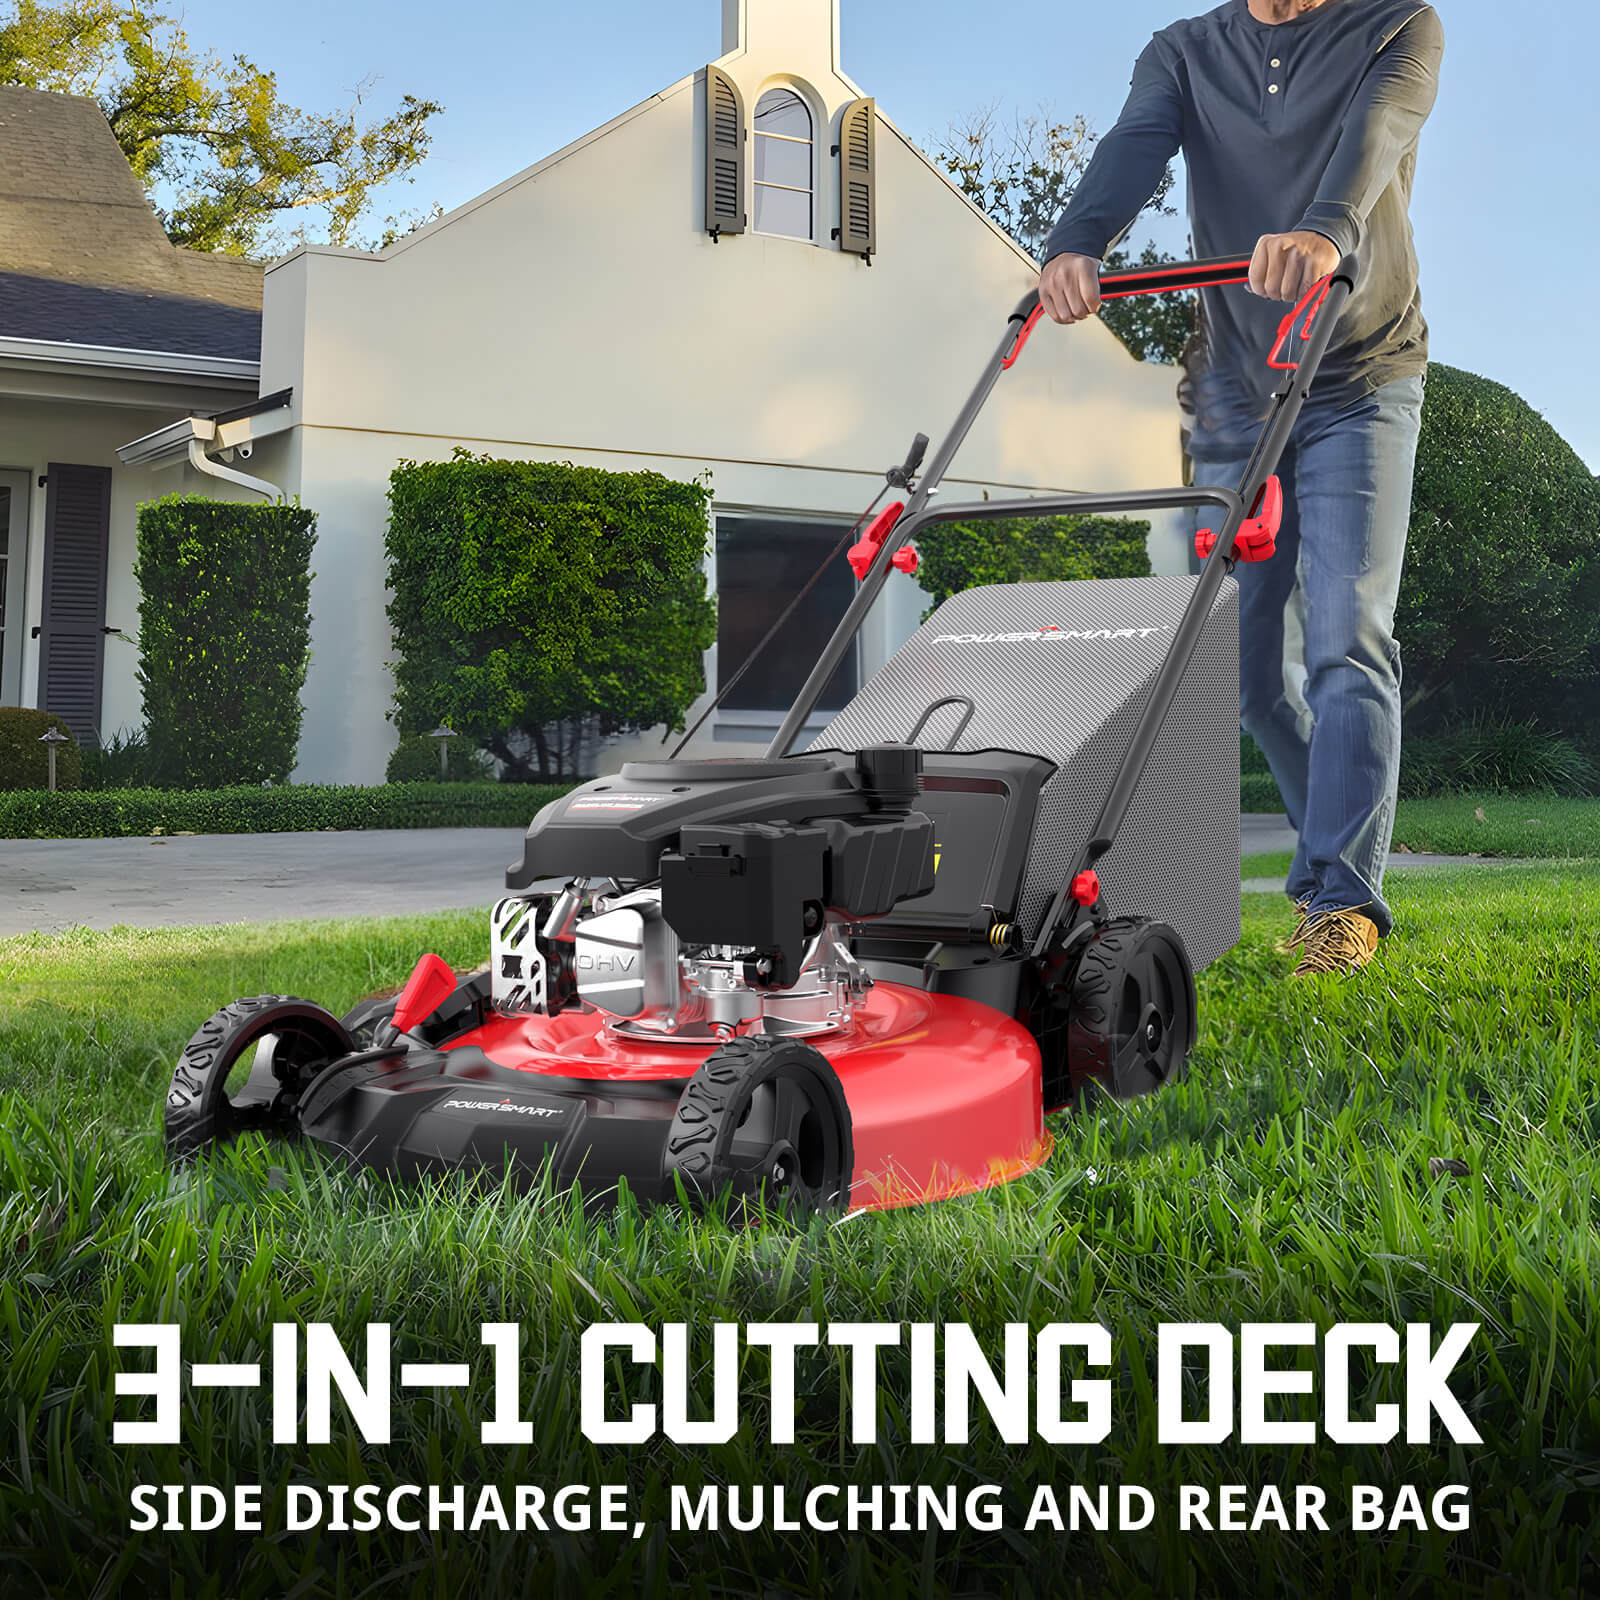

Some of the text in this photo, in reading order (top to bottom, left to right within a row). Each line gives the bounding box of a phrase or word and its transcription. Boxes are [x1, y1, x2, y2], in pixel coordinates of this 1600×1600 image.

[931, 627, 1160, 645] POWERSMART
[576, 954, 635, 972] OHV
[443, 1099, 558, 1118] POWERSMART
